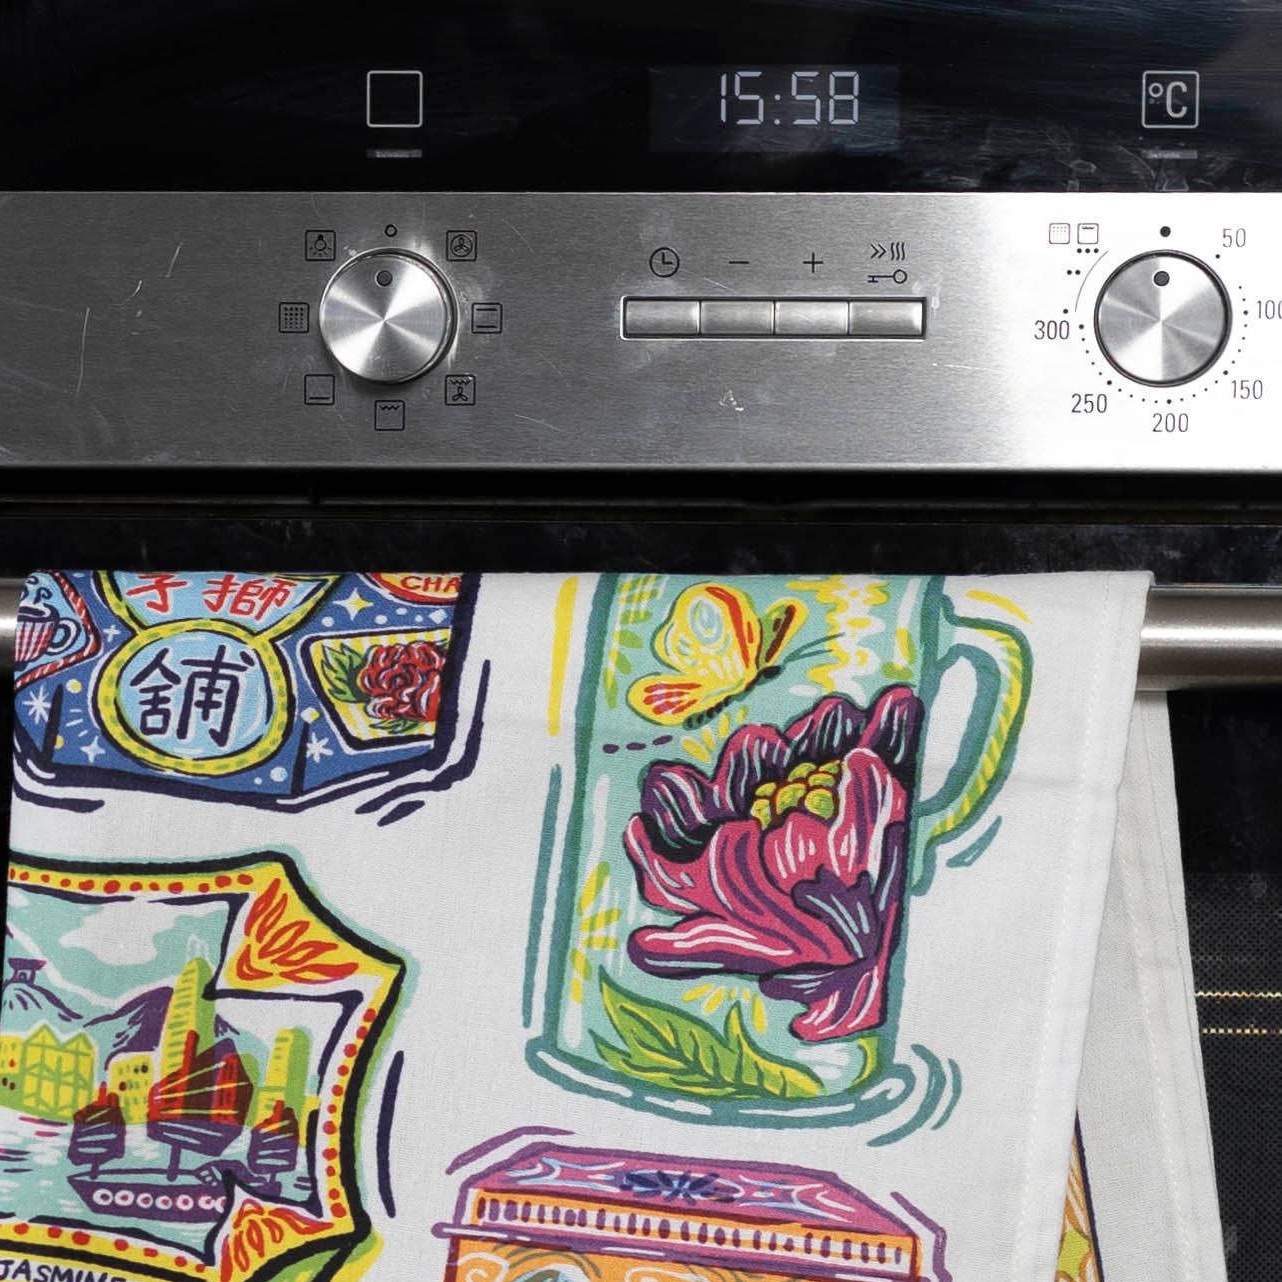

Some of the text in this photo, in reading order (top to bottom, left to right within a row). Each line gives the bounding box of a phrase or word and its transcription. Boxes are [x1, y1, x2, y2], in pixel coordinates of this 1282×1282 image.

[721, 71, 859, 125] 15:58
[1222, 227, 1247, 248] 50
[1034, 319, 1070, 340] 300
[1231, 379, 1264, 400] 150
[1071, 393, 1108, 414] 250
[1152, 412, 1189, 433] 200
